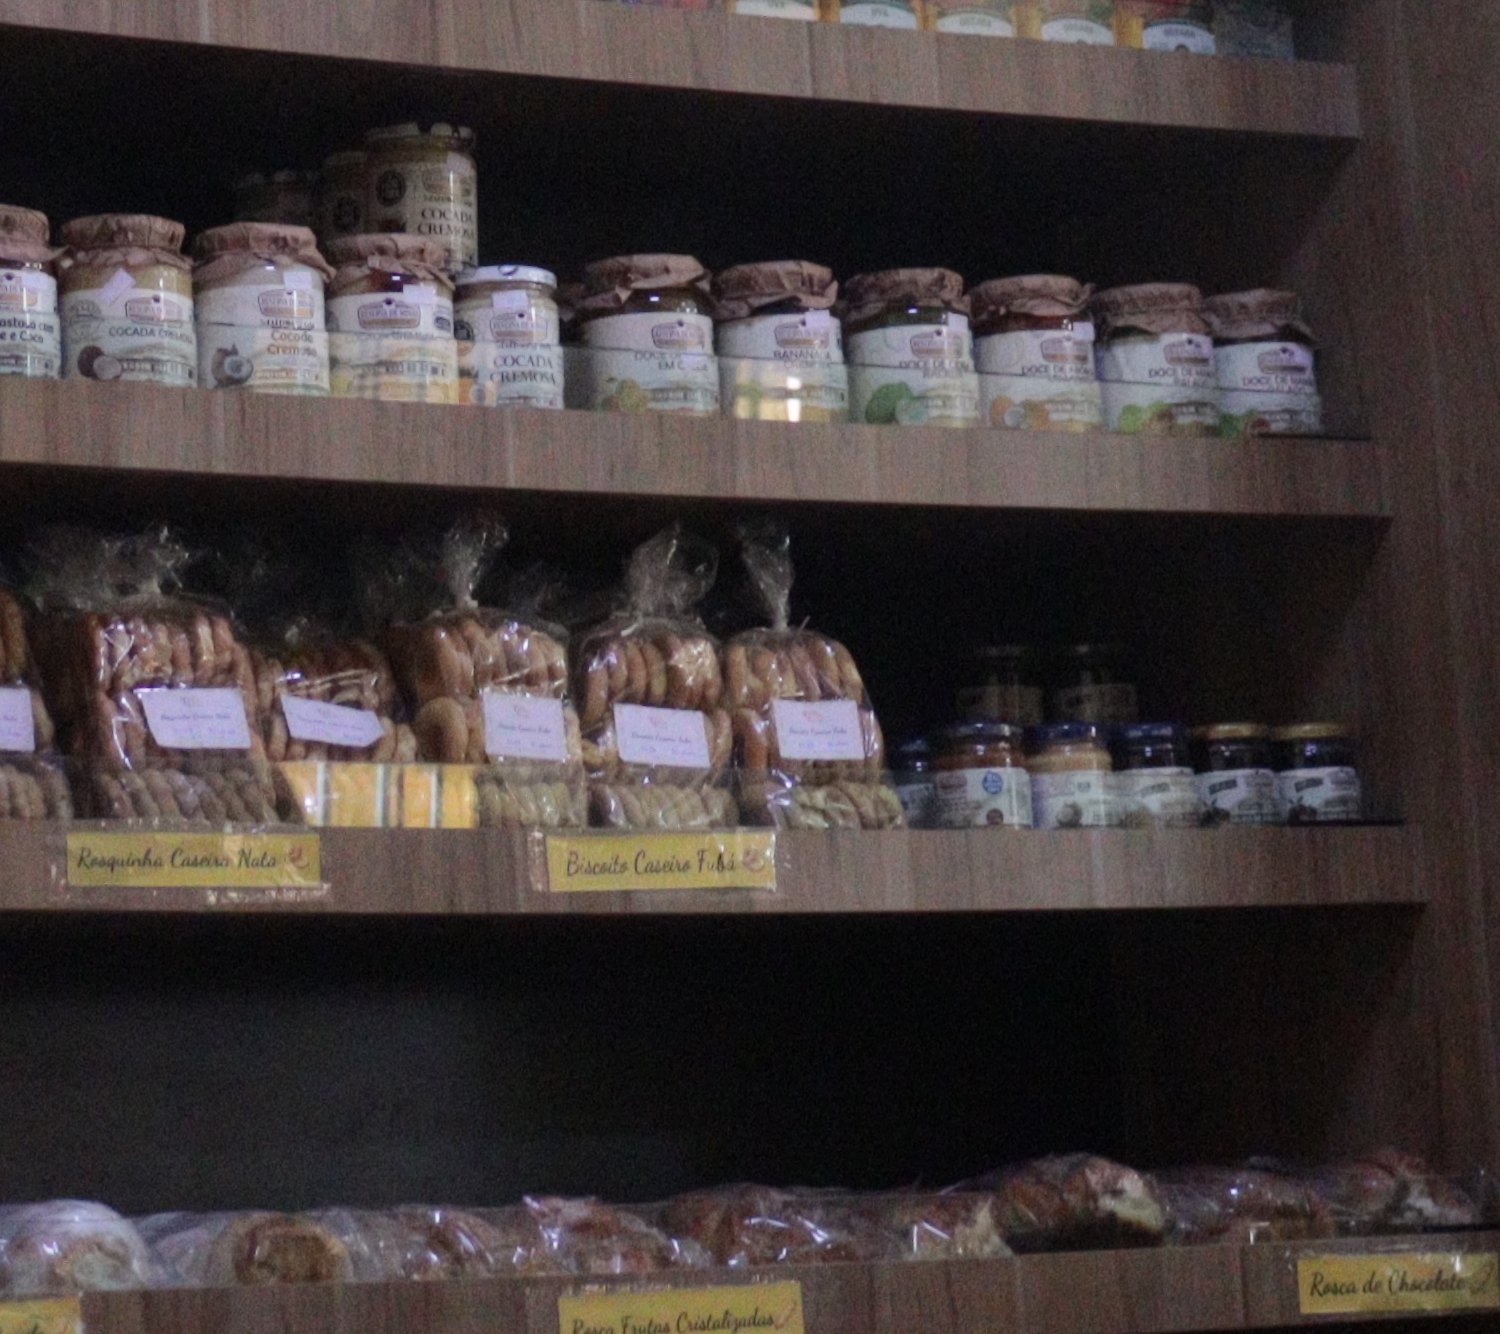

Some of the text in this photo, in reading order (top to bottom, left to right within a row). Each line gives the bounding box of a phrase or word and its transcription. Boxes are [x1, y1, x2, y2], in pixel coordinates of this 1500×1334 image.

[10, 333, 16, 341] e
[109, 326, 155, 337] COCADA
[493, 354, 554, 369] COCADA
[489, 369, 556, 385] CREMOSA
[76, 846, 276, 874] Rosquinha Caseira Nata
[565, 850, 629, 877] Biscoito
[633, 851, 691, 876] Caseiro
[1309, 1267, 1464, 1298] Rosca de Chocolate
[675, 1306, 774, 1334] Cristalizadas
